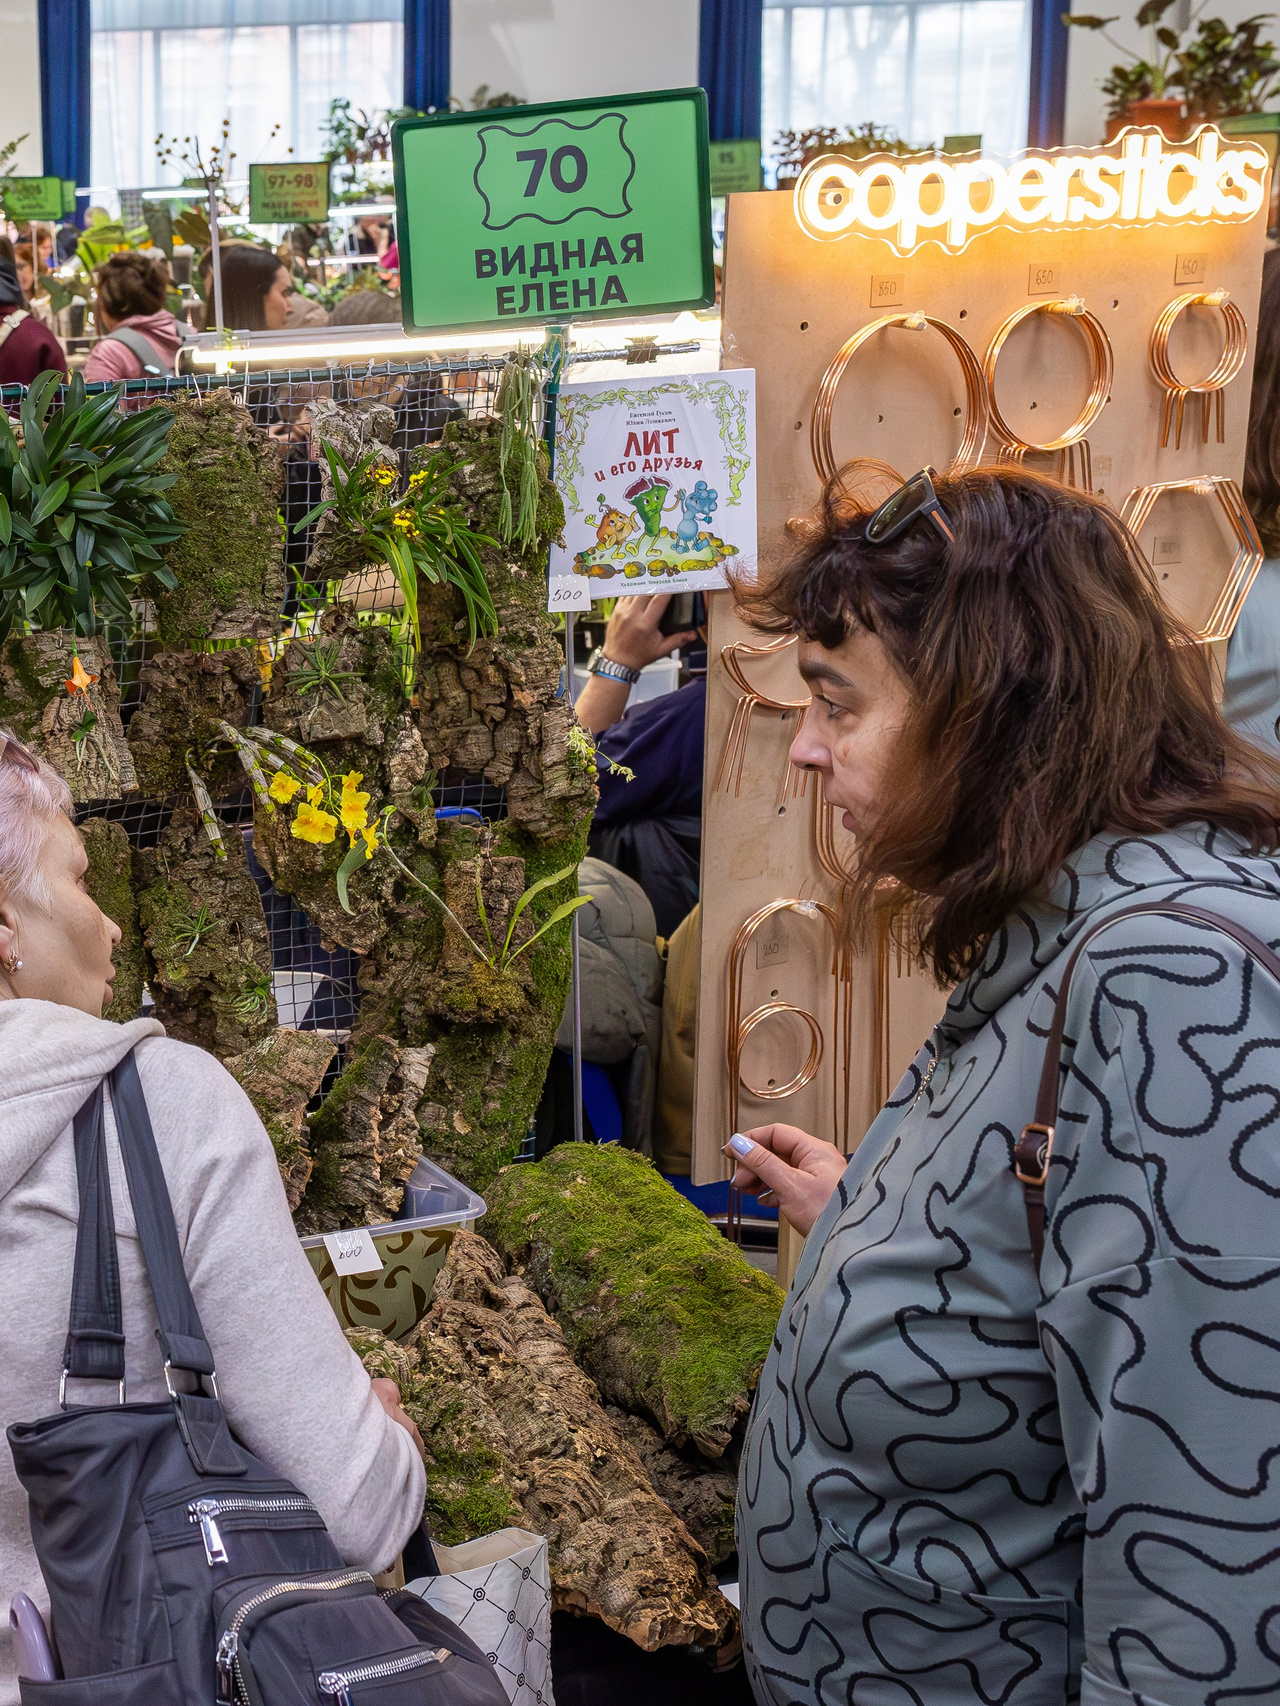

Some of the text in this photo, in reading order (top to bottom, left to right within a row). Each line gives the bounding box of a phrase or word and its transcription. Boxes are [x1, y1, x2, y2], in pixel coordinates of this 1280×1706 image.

[269, 174, 313, 188] 97-98
[516, 144, 588, 198] 70
[803, 132, 1269, 248] coppersticks
[475, 232, 644, 279] ВИДНАЯ
[1035, 269, 1054, 286] 650
[496, 275, 629, 316] ЕЛЕНА
[623, 427, 680, 458] ЛИТ
[594, 456, 703, 483] и его друзья
[552, 588, 583, 602] 500
